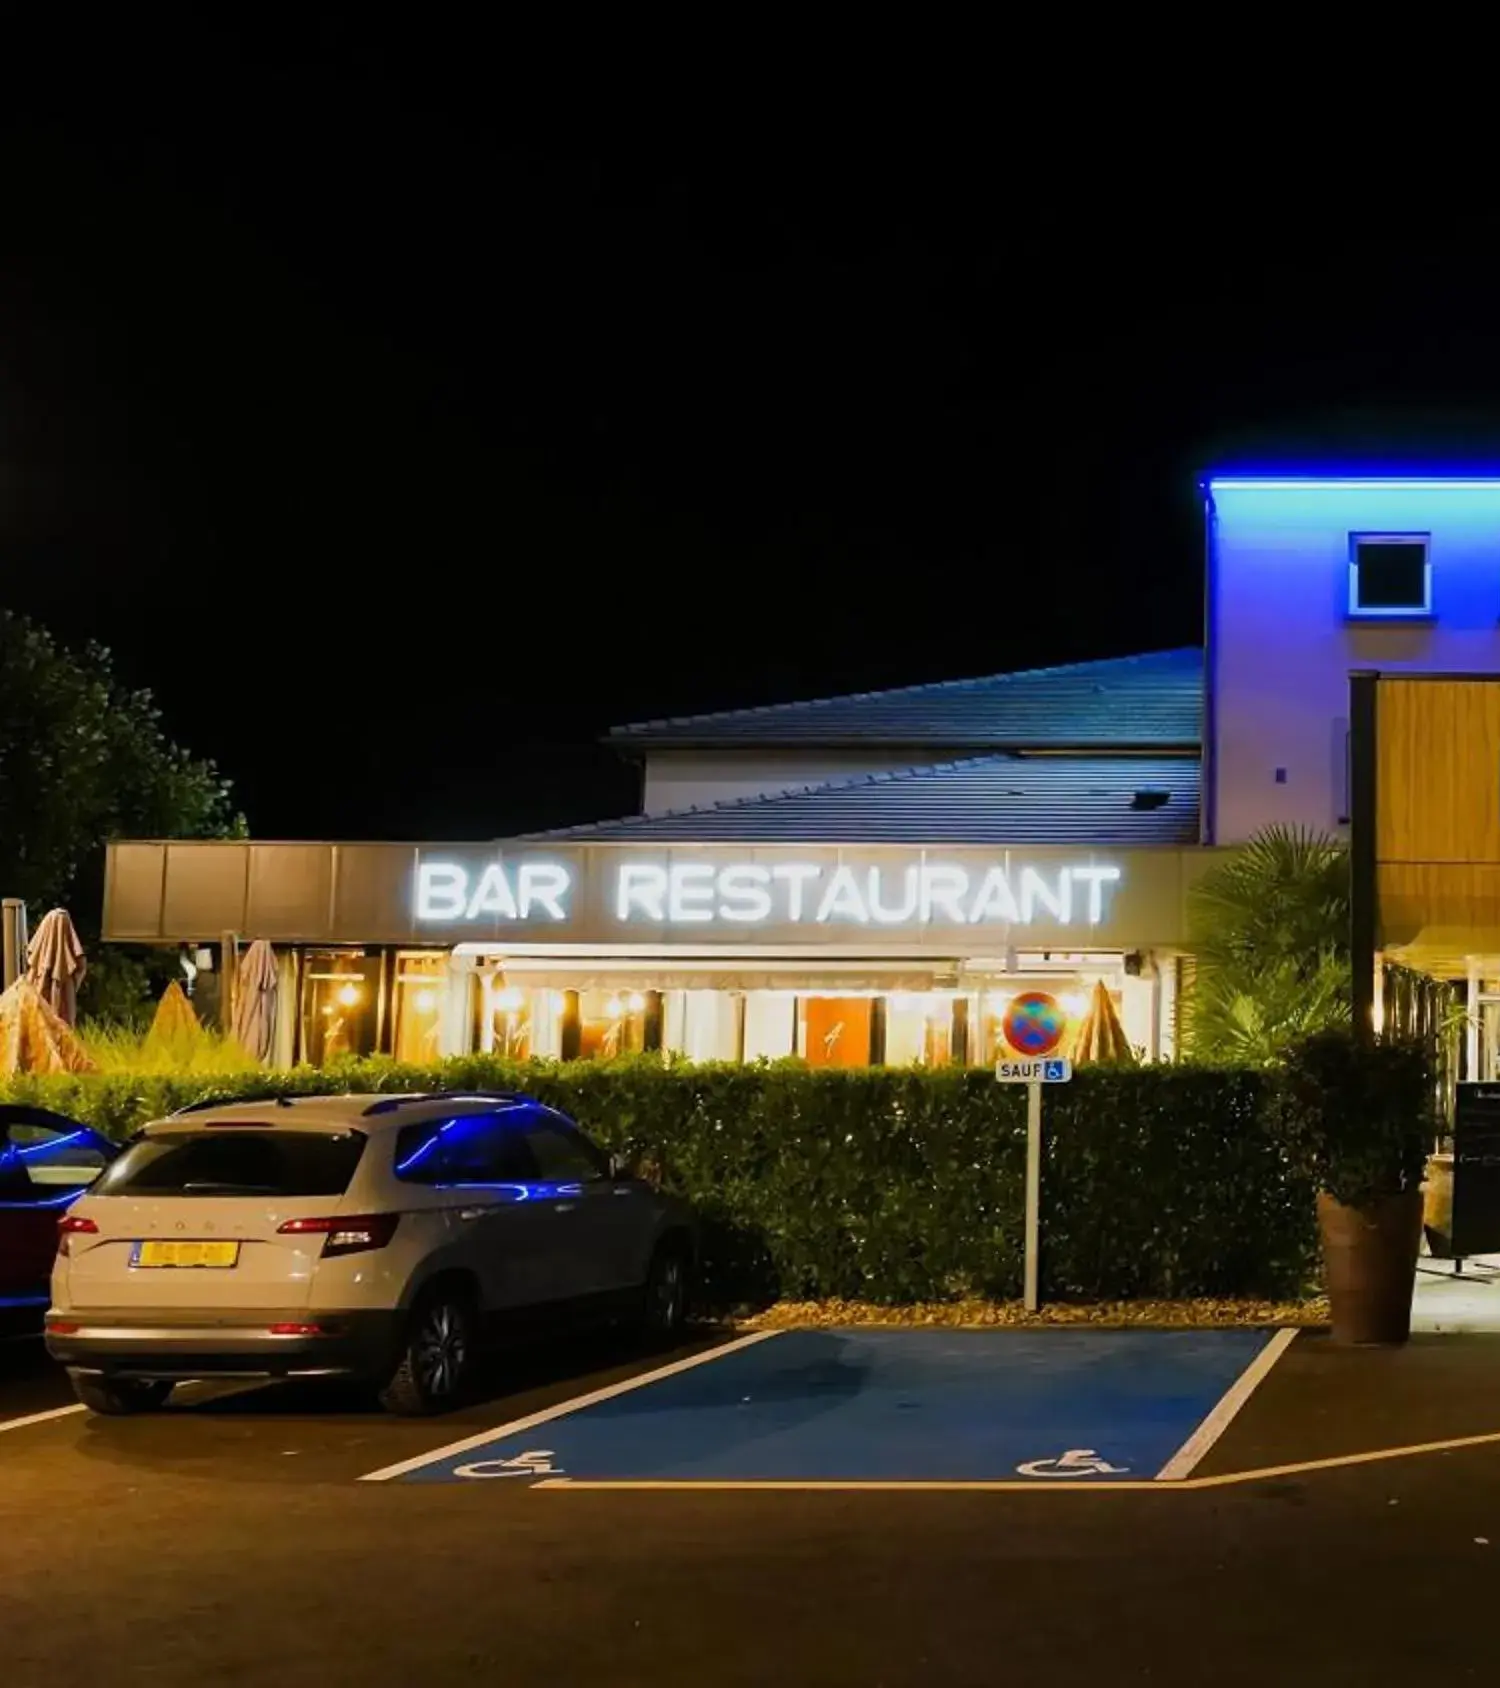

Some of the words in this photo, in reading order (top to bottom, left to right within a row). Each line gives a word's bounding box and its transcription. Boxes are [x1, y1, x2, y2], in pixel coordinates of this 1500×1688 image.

[415, 863, 570, 921] BAR
[617, 863, 1122, 924] RESTAURANT
[1001, 1063, 1041, 1077] SAUF
